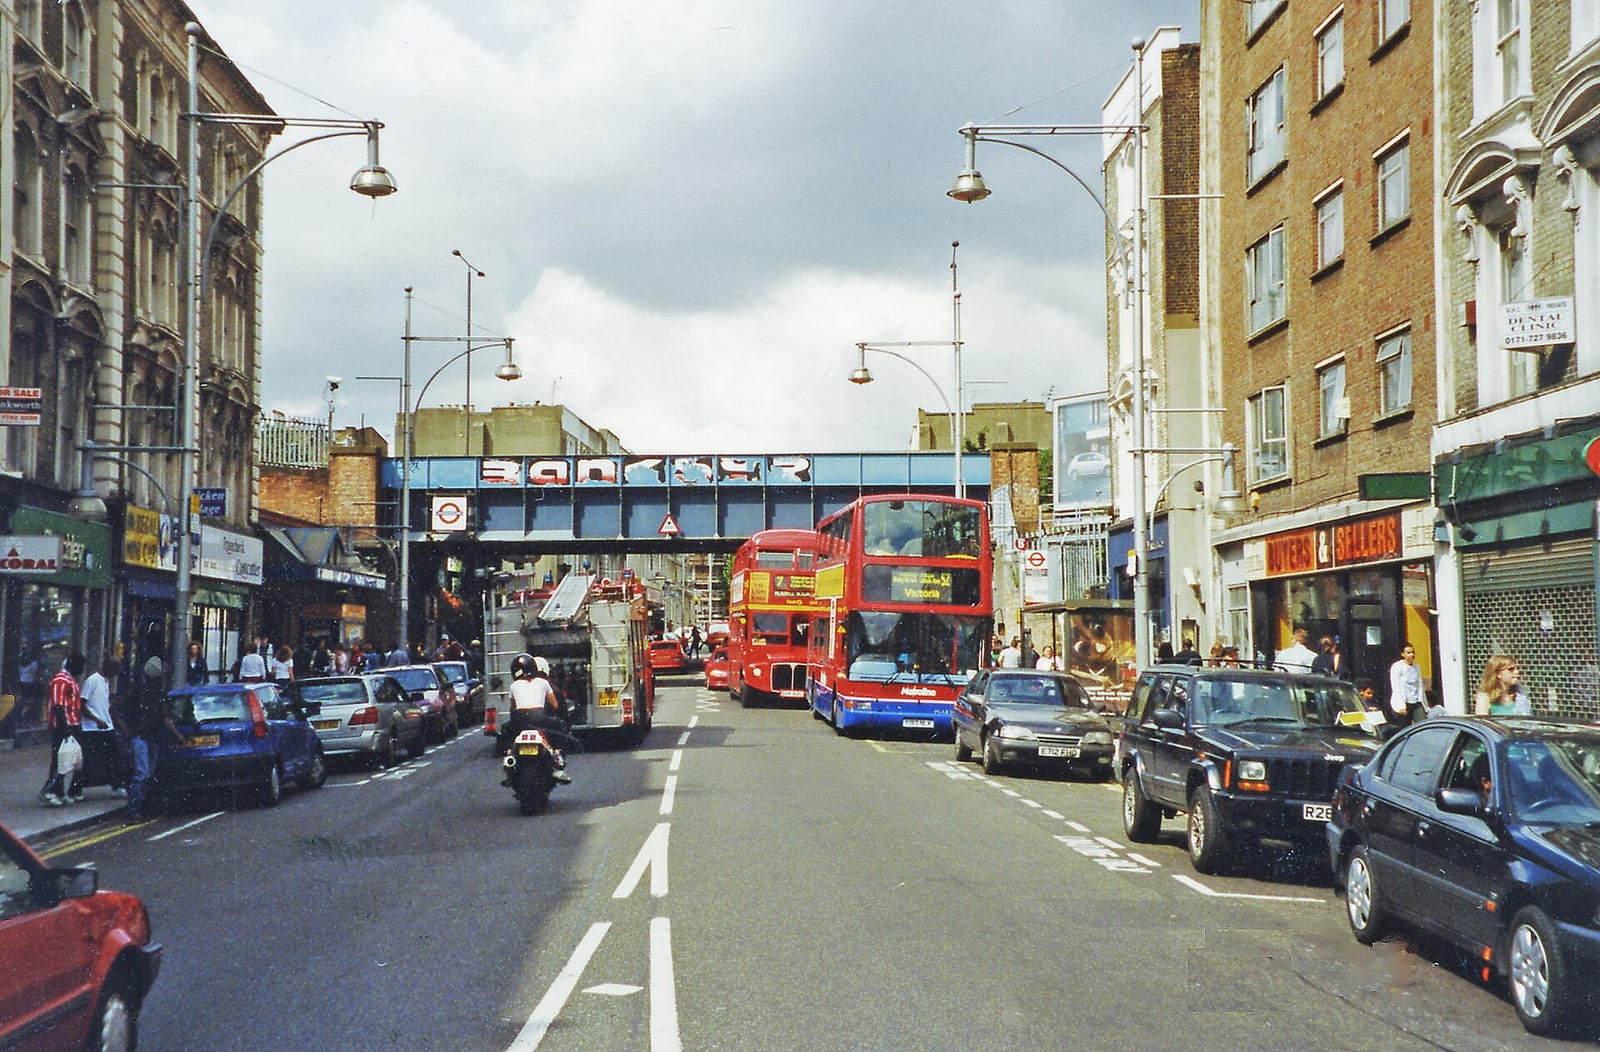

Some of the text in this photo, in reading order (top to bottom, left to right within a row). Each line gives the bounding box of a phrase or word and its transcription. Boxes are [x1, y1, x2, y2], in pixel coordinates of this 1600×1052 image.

[1508, 313, 1561, 325] DENTAL
[1511, 322, 1558, 332] CLINIC
[13, 388, 39, 397] SALE
[197, 490, 226, 501] icken
[200, 503, 221, 515] lage
[1335, 516, 1396, 563] SELLERS
[1318, 530, 1329, 564] &
[1267, 534, 1312, 572] BUYERS
[0, 558, 56, 569] CORAL
[904, 588, 941, 599] Victoria
[900, 685, 937, 697] Metroline
[1323, 754, 1345, 762] Jeep
